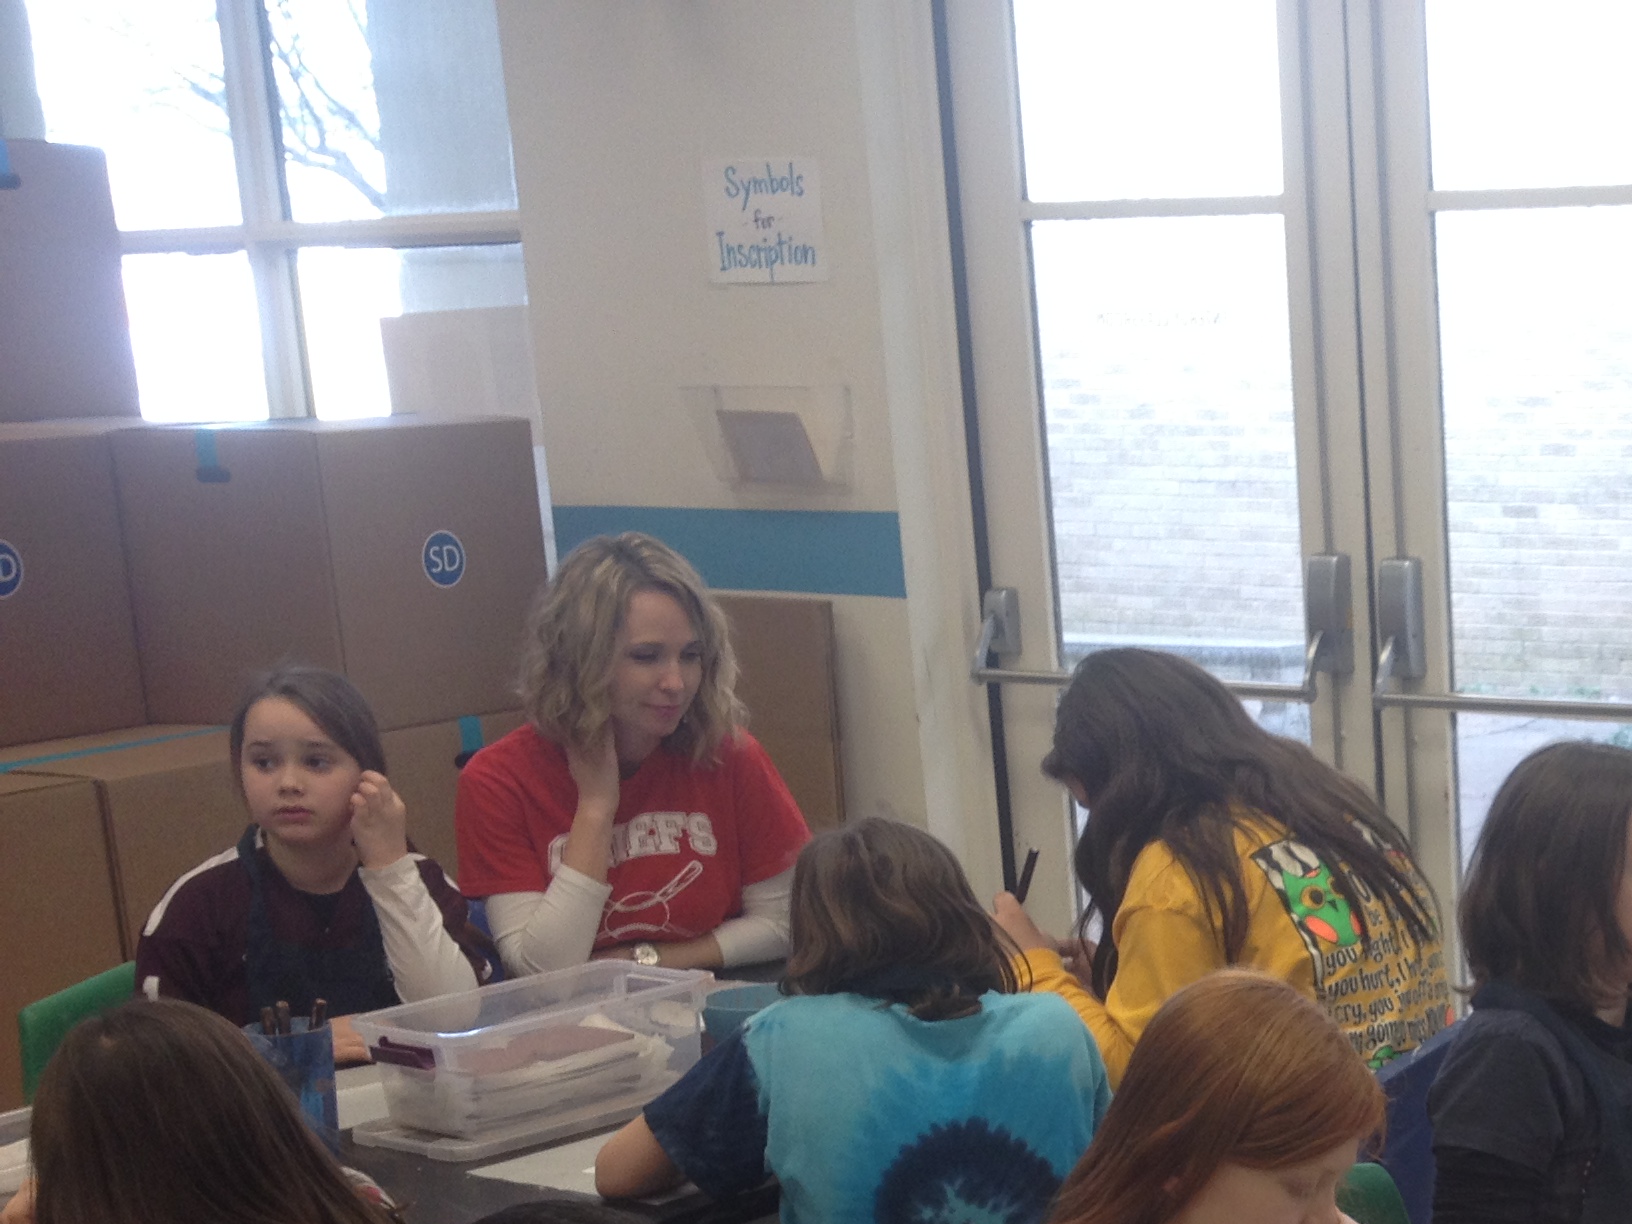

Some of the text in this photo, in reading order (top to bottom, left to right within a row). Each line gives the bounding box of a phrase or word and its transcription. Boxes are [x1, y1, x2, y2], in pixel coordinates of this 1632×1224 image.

[723, 161, 805, 212] Symbols
[753, 208, 775, 229] for
[716, 230, 816, 283] Inscription
[429, 545, 460, 573] SD
[1326, 947, 1358, 977] you
[1328, 976, 1358, 1002] you
[1368, 996, 1395, 1023] you
